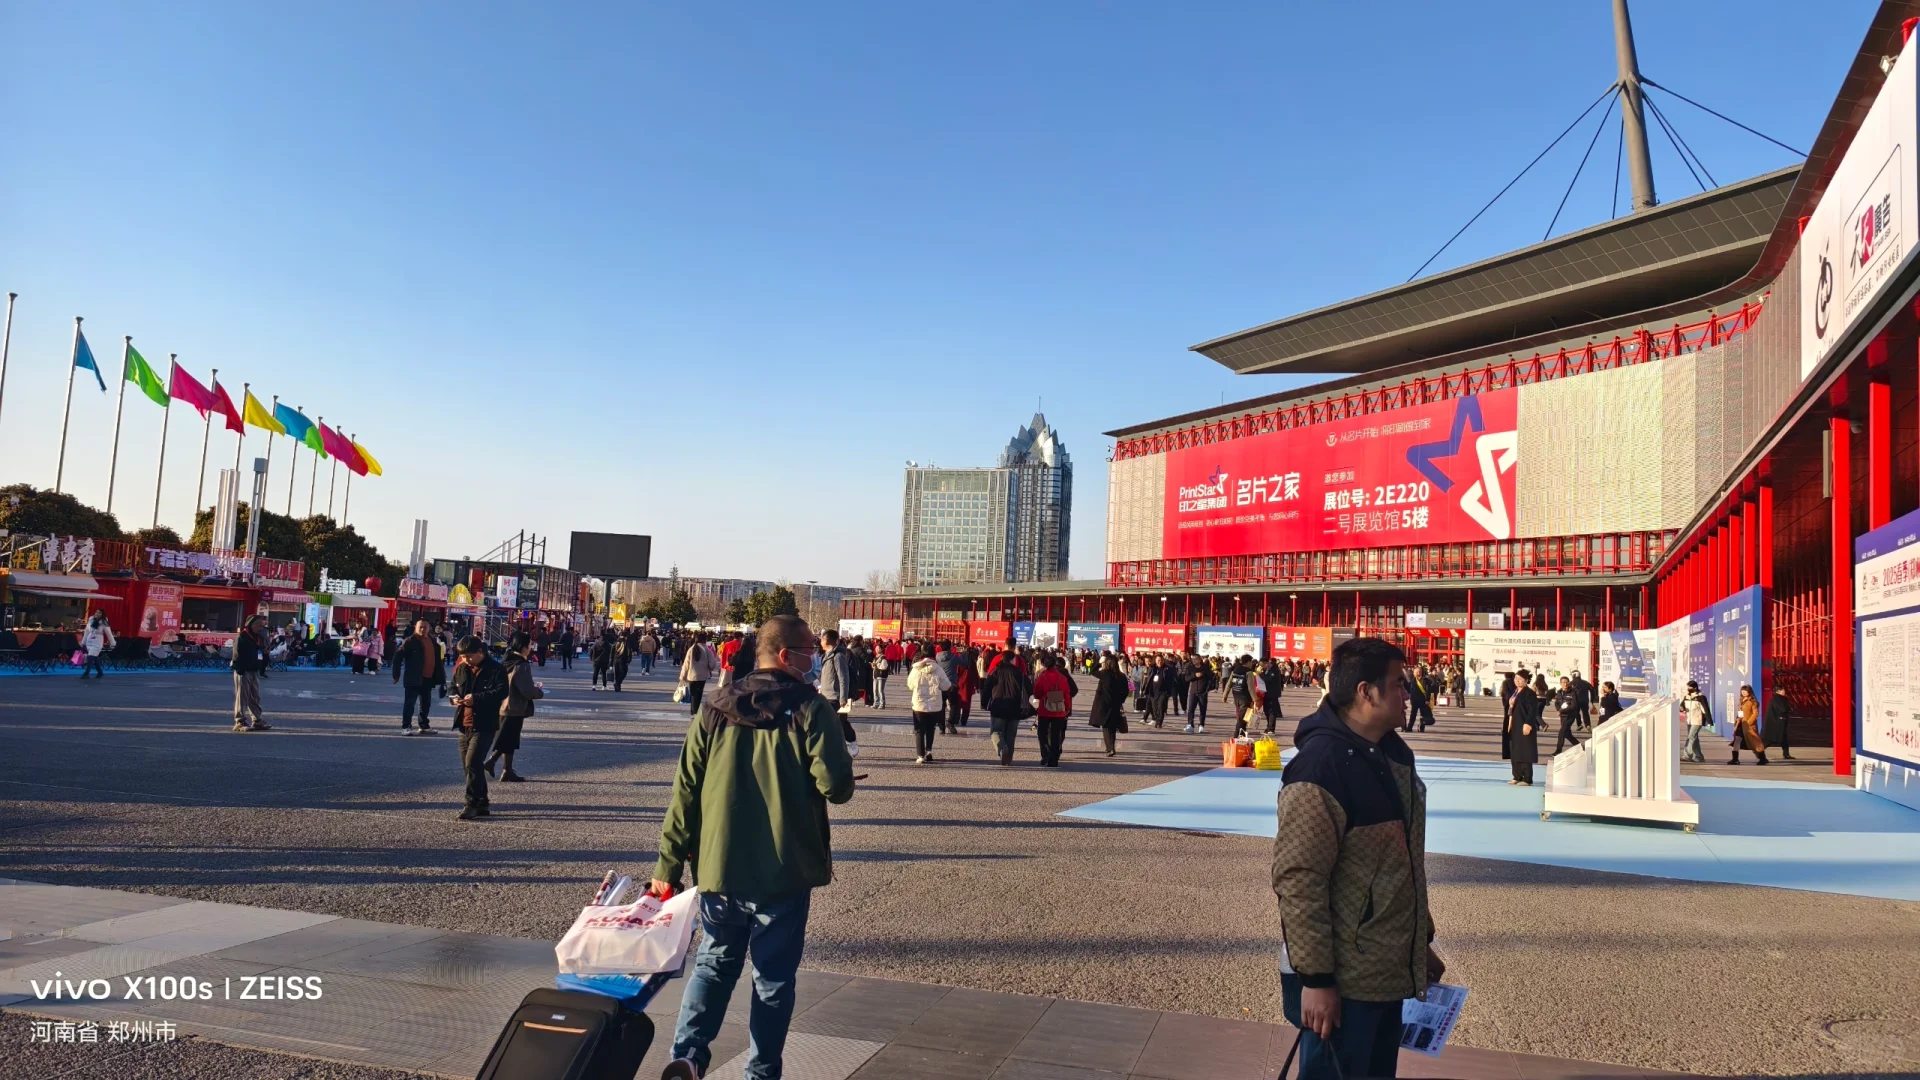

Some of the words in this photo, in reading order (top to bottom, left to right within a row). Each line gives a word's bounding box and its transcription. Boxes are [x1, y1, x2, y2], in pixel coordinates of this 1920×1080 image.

[1340, 427, 1379, 442] 从名片开始
[1179, 483, 1217, 499] PrintStar
[1236, 472, 1300, 506] 名片之家
[1374, 481, 1430, 506] 2E220
[1178, 496, 1228, 513] 印之星集团
[1323, 506, 1429, 533] 二号展览馆5楼
[42, 533, 96, 574] 串串香
